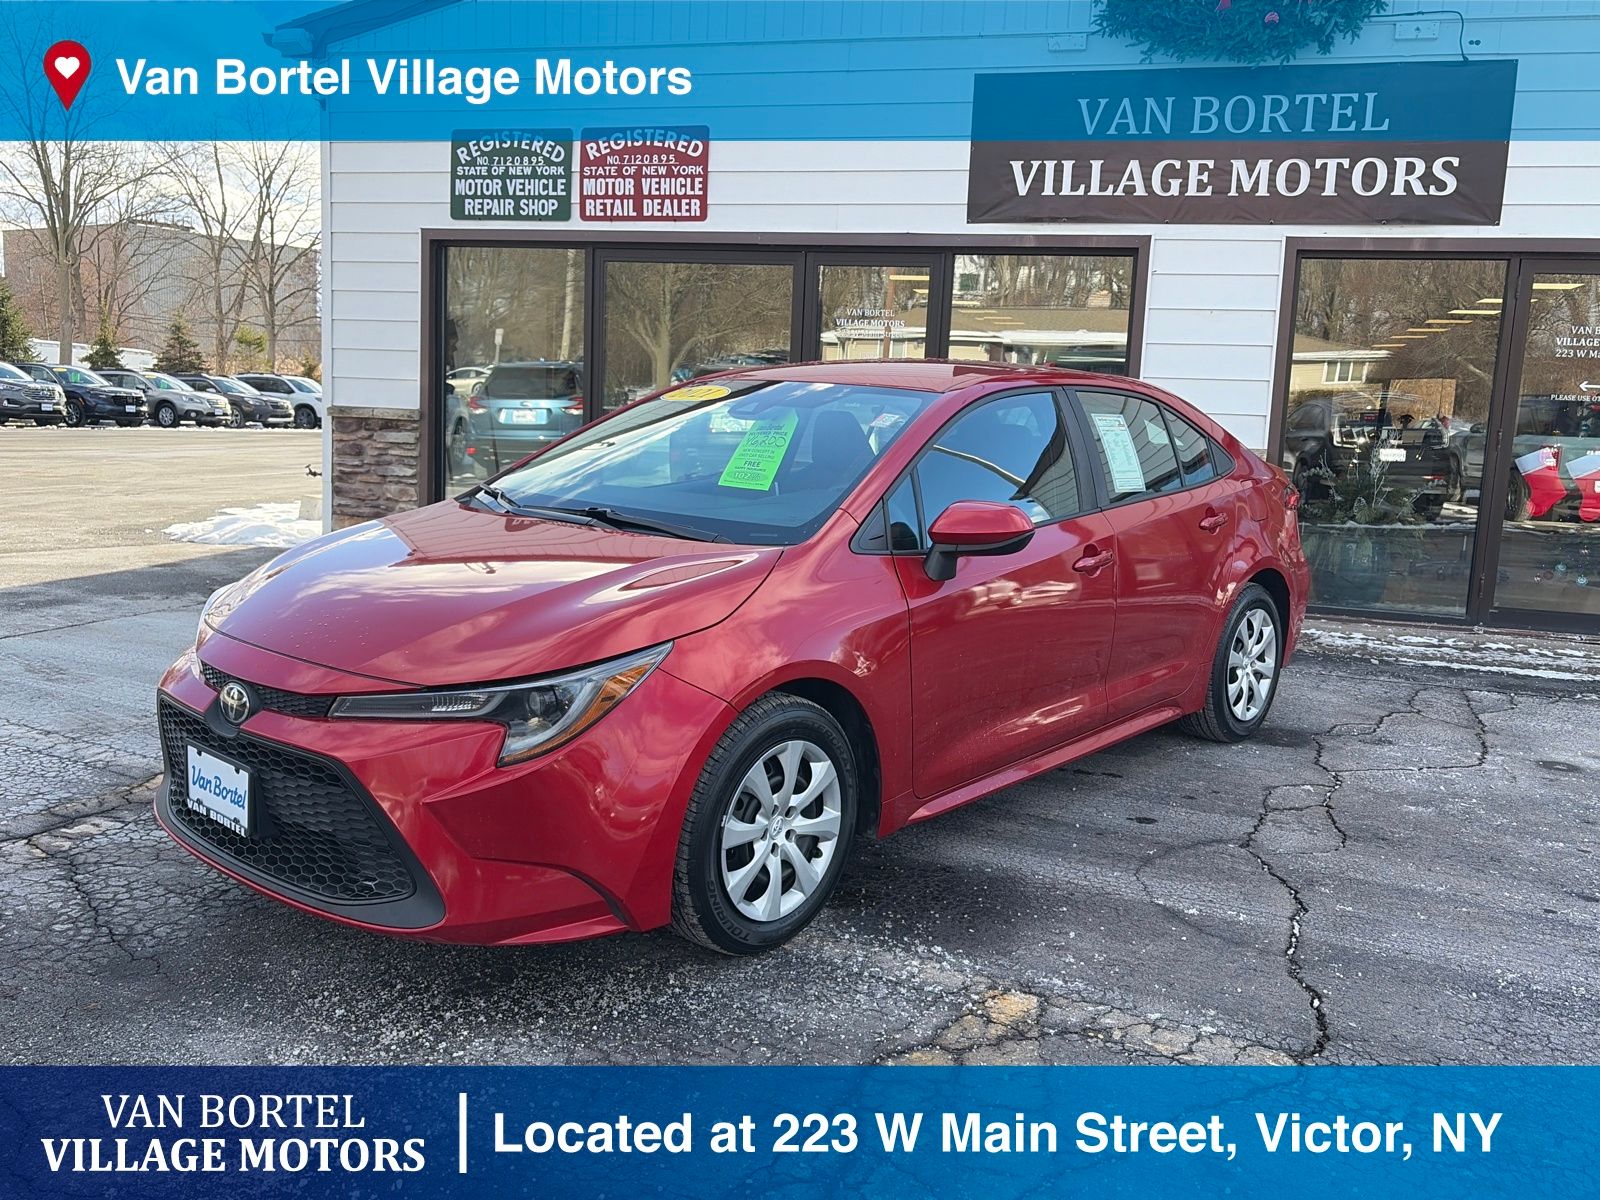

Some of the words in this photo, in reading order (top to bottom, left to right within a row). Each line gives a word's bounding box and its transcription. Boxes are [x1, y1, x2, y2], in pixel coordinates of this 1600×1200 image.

[1077, 97, 1176, 136] VAN
[1191, 92, 1390, 135] BORTEL
[456, 130, 566, 165] REGISTERED
[585, 128, 704, 161] REGISTERED
[476, 156, 490, 166] NO.
[493, 156, 544, 166] 7120895
[606, 155, 621, 165] NO.
[623, 154, 676, 164] 7120895
[456, 166, 488, 176] STATE
[491, 166, 505, 176] OF
[508, 166, 532, 176] NEW
[535, 166, 566, 176] YORK
[583, 166, 618, 176] STATE
[622, 166, 637, 175] OF
[642, 166, 667, 175] NEW
[671, 166, 704, 175] YORK
[1010, 157, 1215, 199] VILLAGE
[1229, 156, 1461, 198] MOTORS
[455, 179, 503, 196] MOTOR
[506, 179, 567, 196] VEHICLE
[583, 178, 634, 196] MOTOR
[641, 178, 704, 196] VEHICLE
[464, 199, 515, 216] REPAIR
[519, 199, 559, 216] SHOP
[585, 199, 637, 217] RETAIL
[642, 199, 701, 217] DEALER
[846, 308, 863, 316] VAN
[864, 309, 895, 317] BORTEL
[836, 318, 870, 327] VILLAGE
[870, 319, 906, 328] MOTORS
[1571, 326, 1592, 335] VAN
[1556, 337, 1600, 347] VILLAGE
[1555, 349, 1574, 358] 223
[1576, 349, 1588, 358] W
[743, 460, 761, 468] FREE
[187, 798, 207, 816] VAN
[209, 809, 247, 838] BORTEL
[708, 880, 752, 942] TOURING
